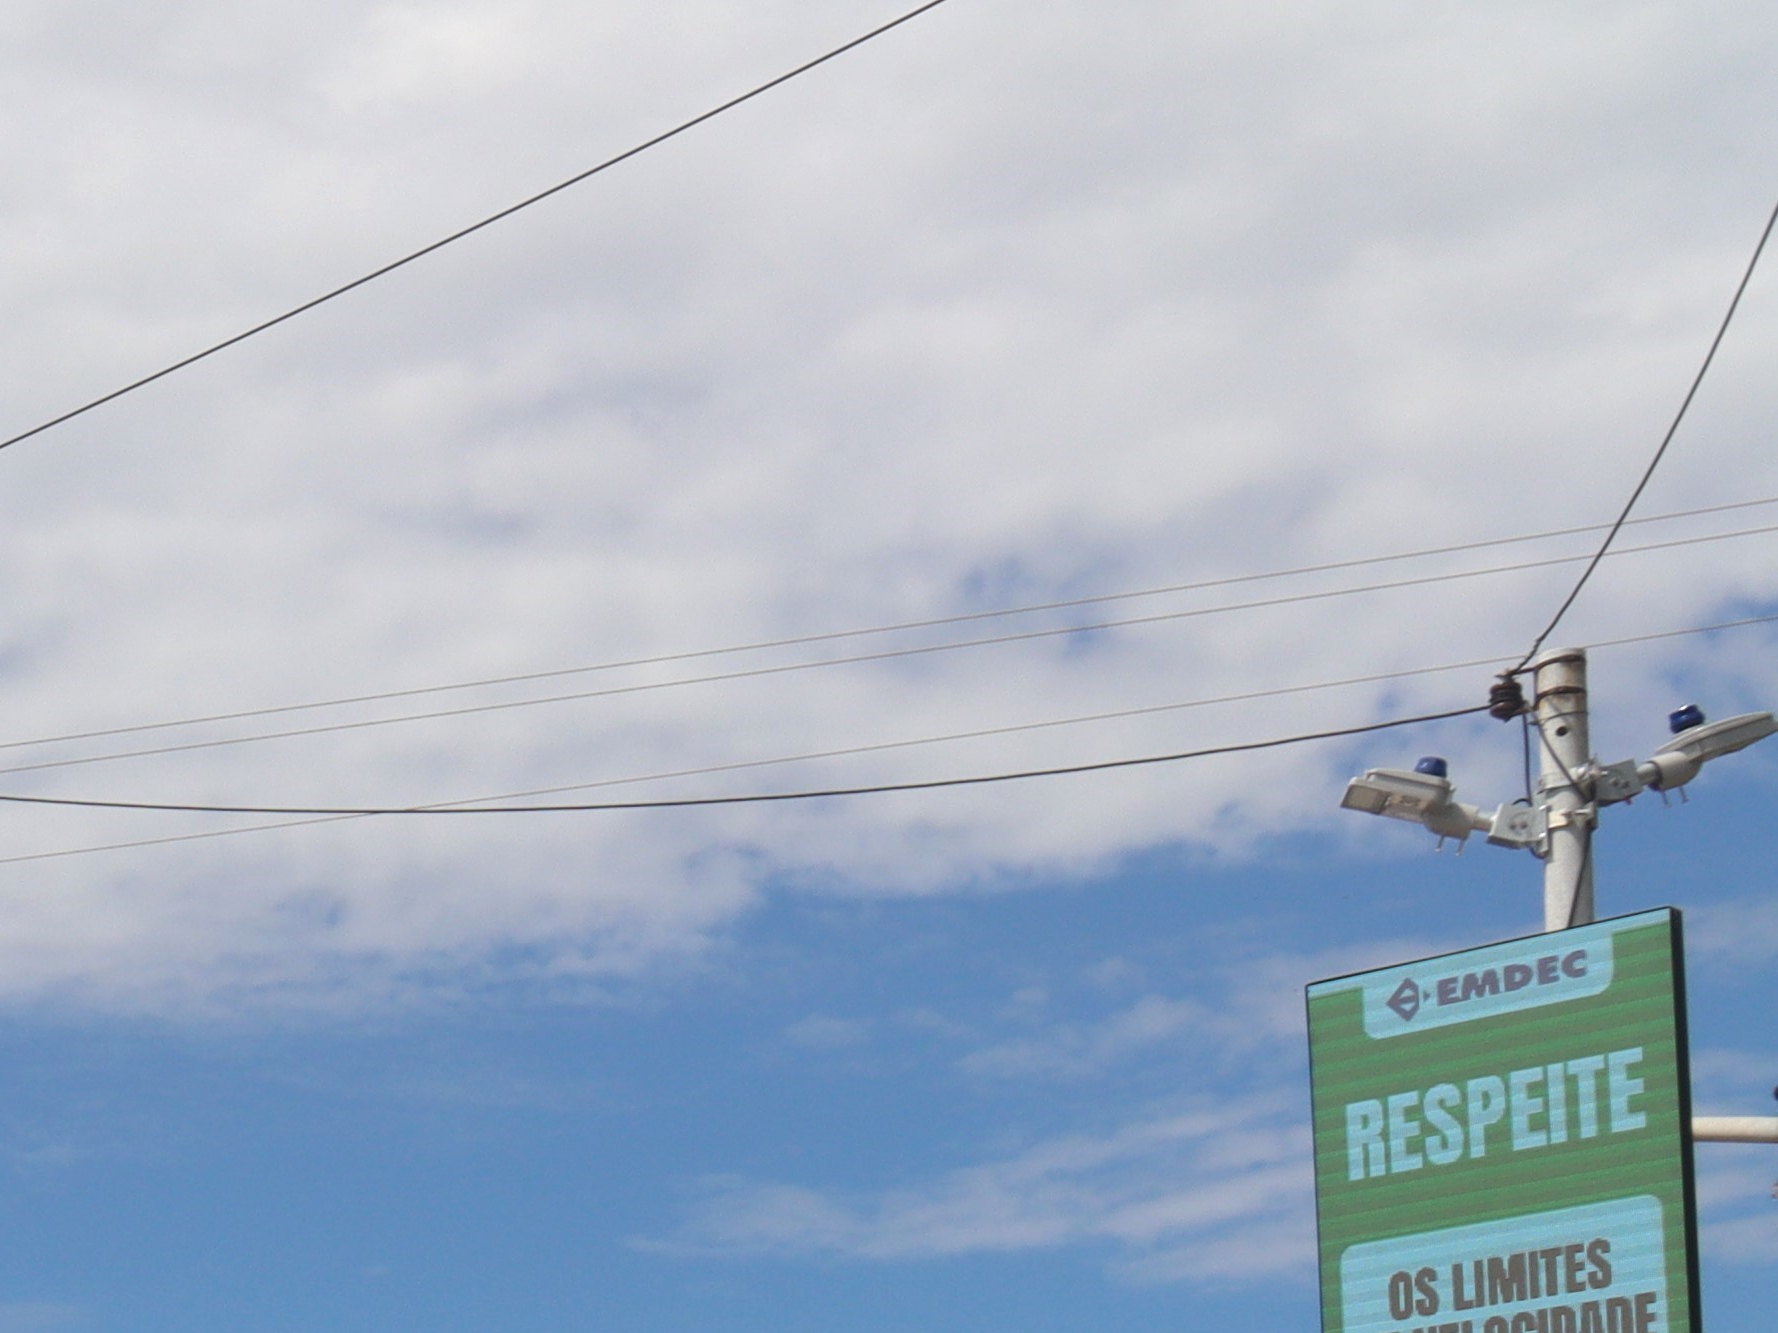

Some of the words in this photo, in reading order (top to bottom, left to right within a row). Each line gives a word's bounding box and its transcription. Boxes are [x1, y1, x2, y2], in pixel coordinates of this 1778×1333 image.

[1436, 948, 1590, 1007] EMDEC
[1345, 1045, 1646, 1182] RESPEITE
[1388, 1265, 1439, 1322] OS
[1451, 1236, 1613, 1312] LIMITES
